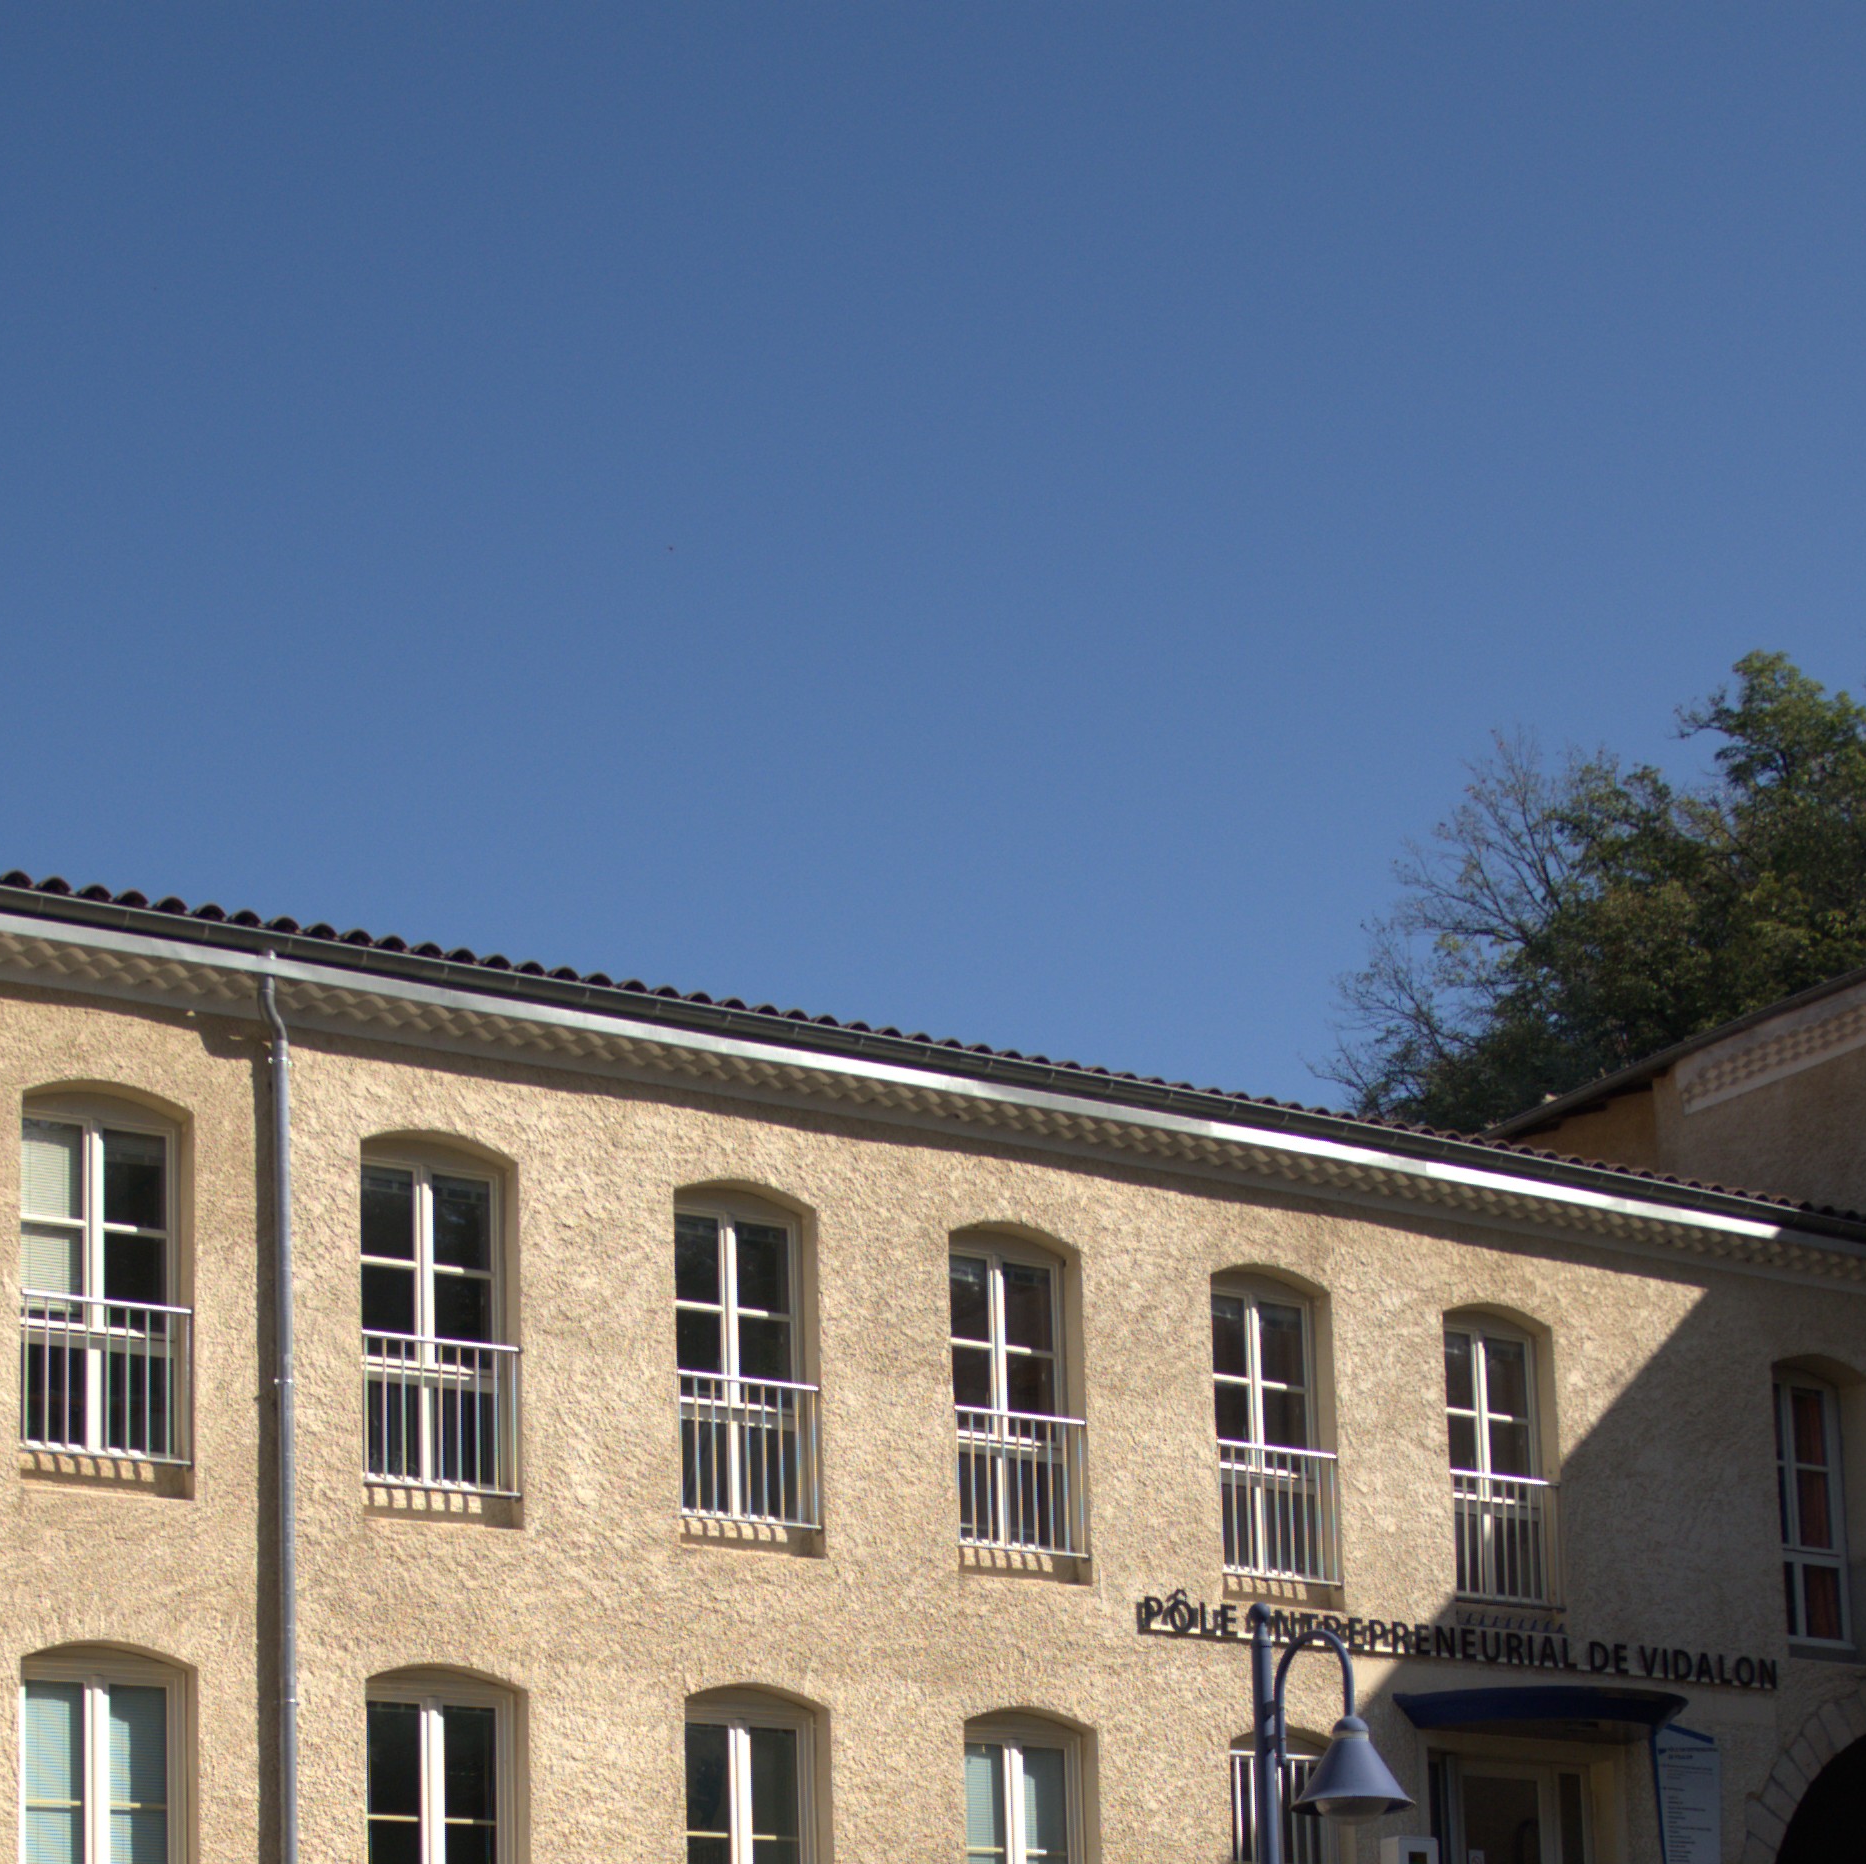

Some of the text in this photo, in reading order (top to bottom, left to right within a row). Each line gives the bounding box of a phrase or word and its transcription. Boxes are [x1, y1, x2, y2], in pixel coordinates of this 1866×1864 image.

[1143, 1588, 1778, 1690] PÔLE NTREPRENEURIAL DE VIDALON
